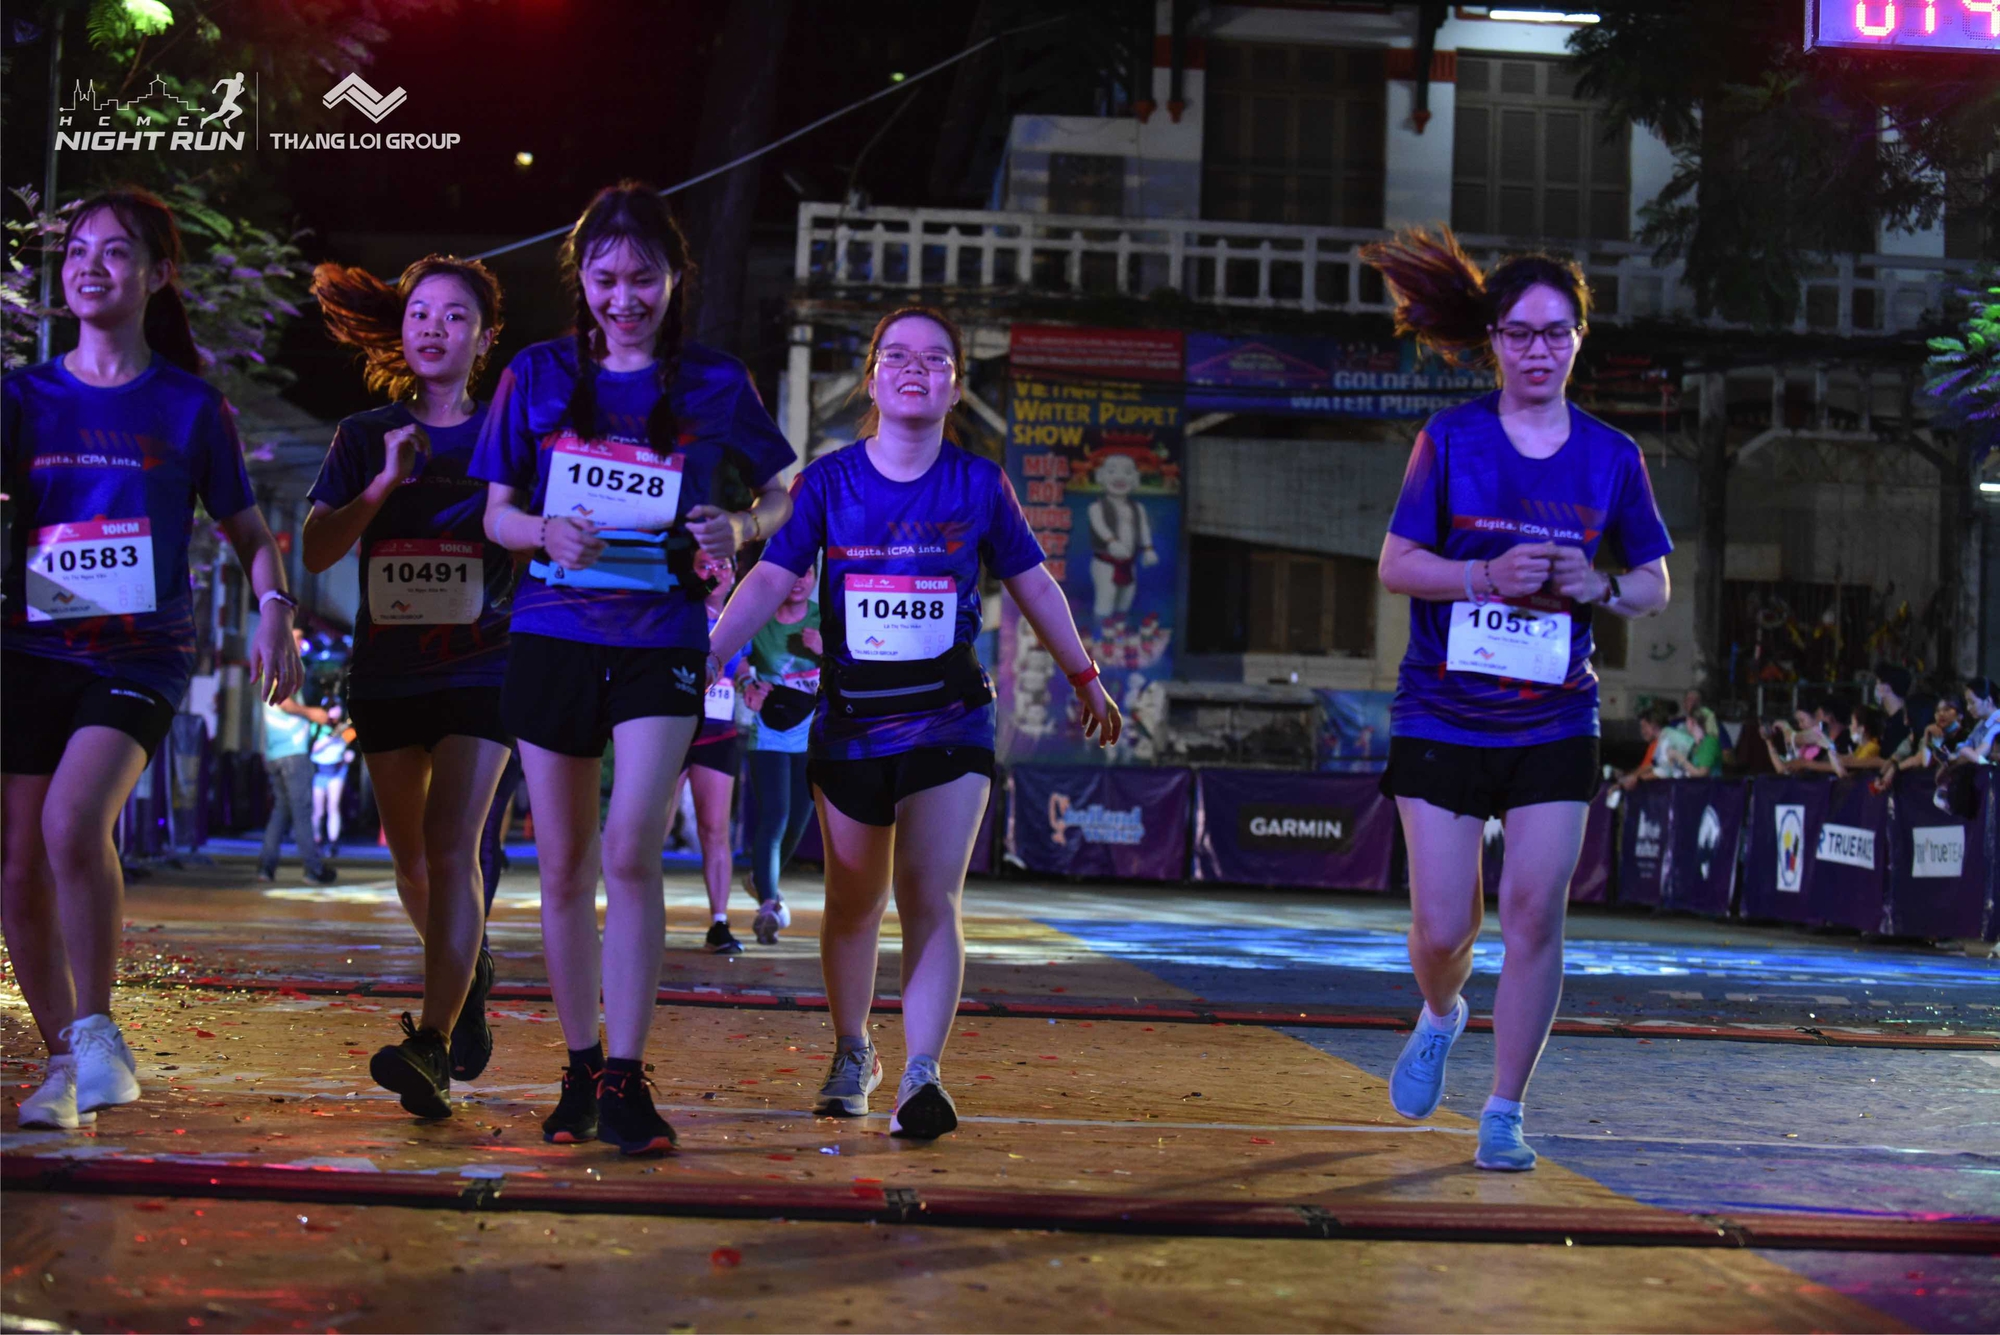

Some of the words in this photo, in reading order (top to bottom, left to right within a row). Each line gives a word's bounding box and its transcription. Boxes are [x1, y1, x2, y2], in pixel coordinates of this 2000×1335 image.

[1013, 399, 1090, 422] WATER
[1098, 402, 1178, 426] PUPPET
[1012, 424, 1084, 446] SHOW
[567, 463, 665, 497] 10528
[101, 522, 139, 535] 10KM
[440, 543, 473, 553] 10KM
[846, 547, 884, 558] digita.
[42, 546, 139, 573] 10583
[382, 562, 467, 583] 10491
[915, 580, 948, 590] 10KM
[858, 598, 944, 620] 10488
[1250, 817, 1342, 838] GARMIN
